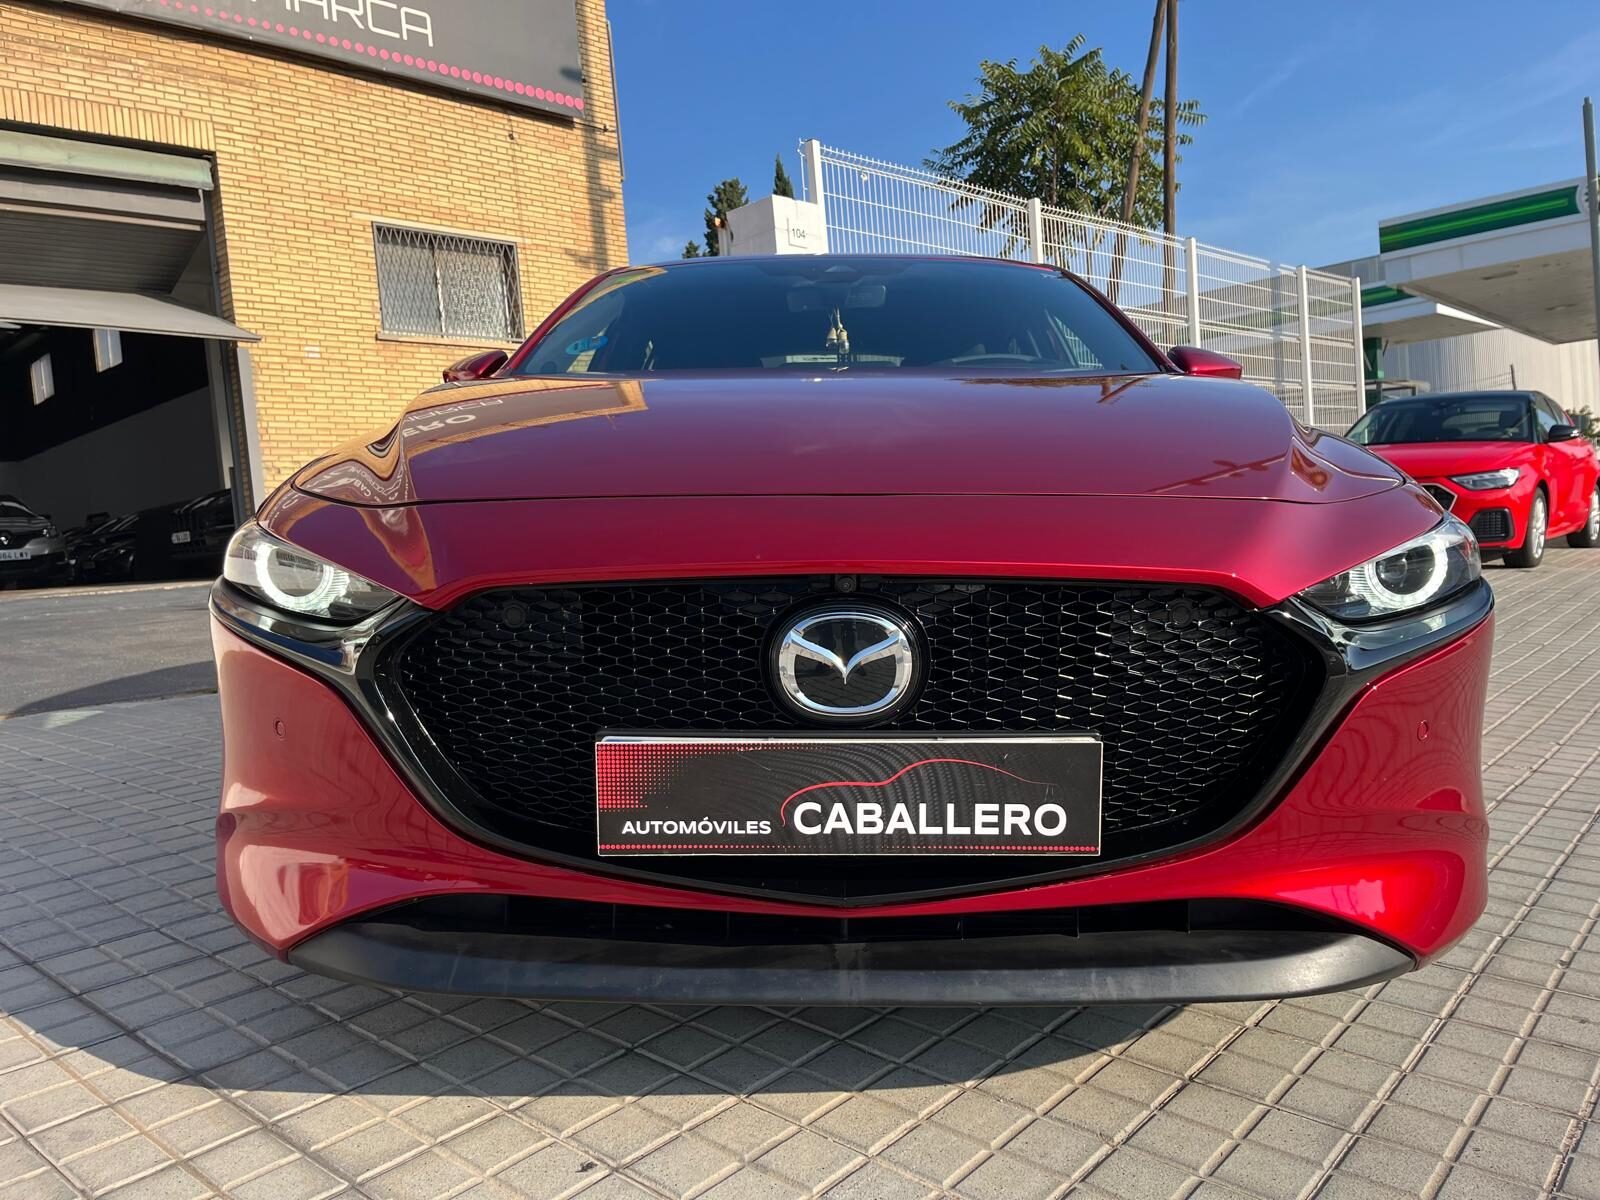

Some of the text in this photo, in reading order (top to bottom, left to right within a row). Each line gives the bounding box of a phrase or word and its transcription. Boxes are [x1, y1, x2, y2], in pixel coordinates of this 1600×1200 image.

[250, 0, 433, 47] ARCA
[792, 228, 806, 239] 104
[622, 801, 1067, 836] AUTOMÓVILES CABALLERO
